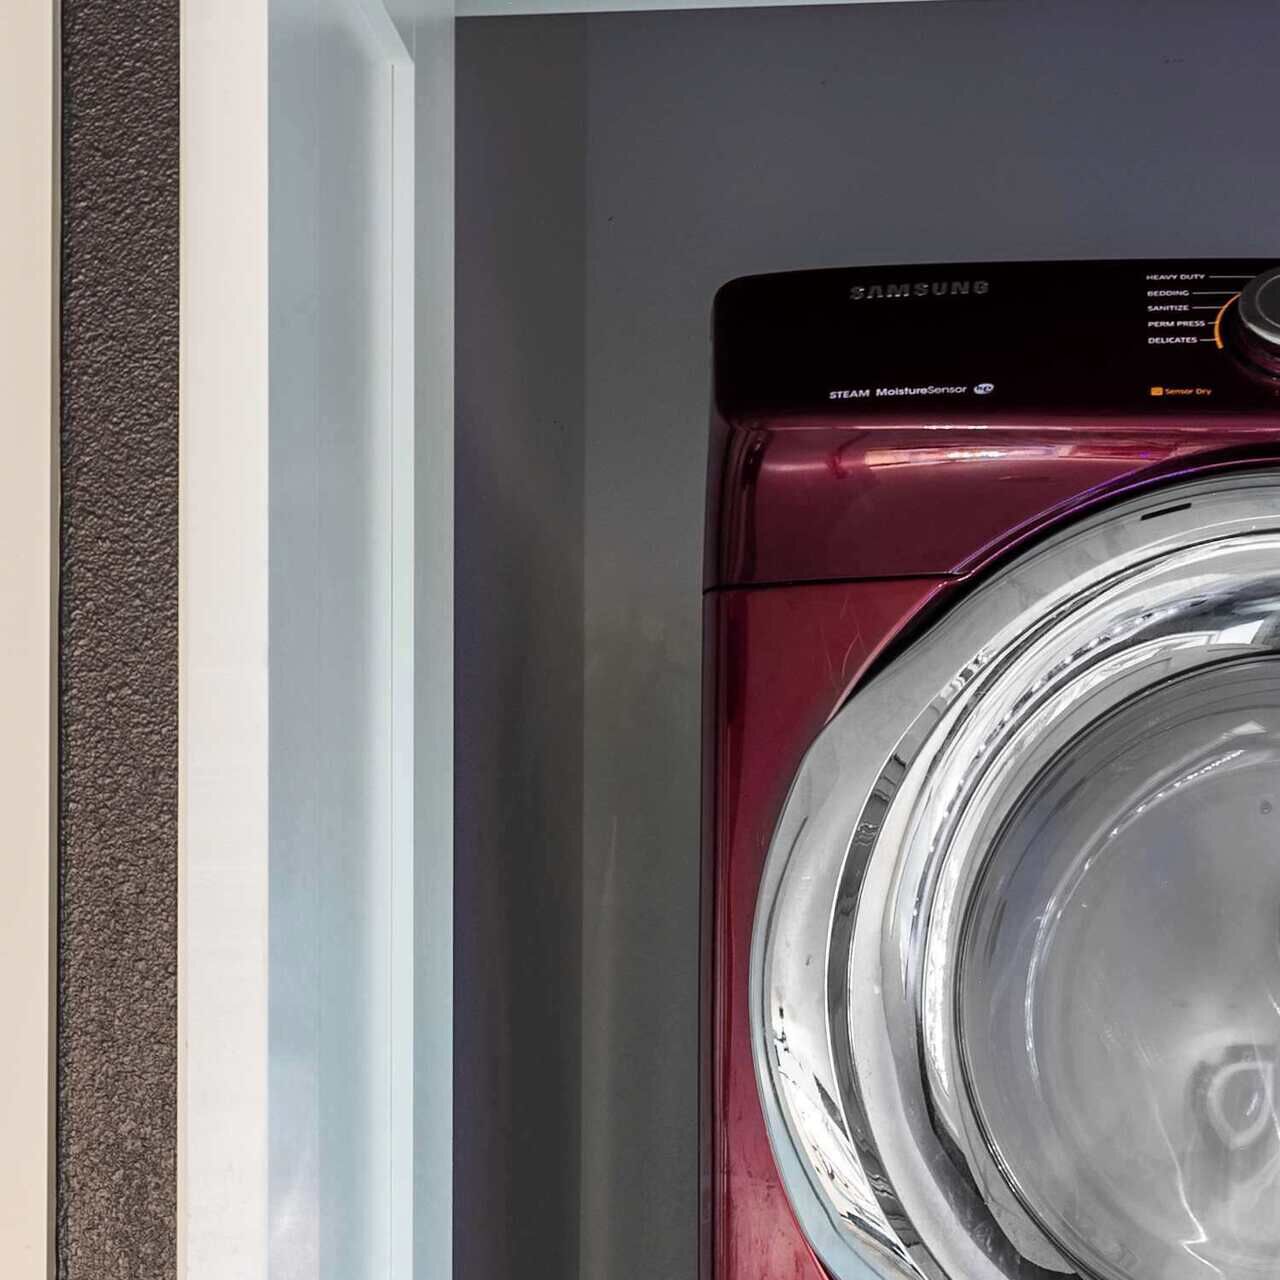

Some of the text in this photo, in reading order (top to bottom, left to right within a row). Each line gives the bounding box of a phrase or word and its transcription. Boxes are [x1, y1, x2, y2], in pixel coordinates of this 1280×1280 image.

[849, 280, 990, 300] SAMSUNG
[1147, 304, 1190, 312] SANITIZE
[829, 389, 870, 399] STEAM
[876, 386, 967, 397] MoistureSensor
[1196, 388, 1212, 396] Dry
